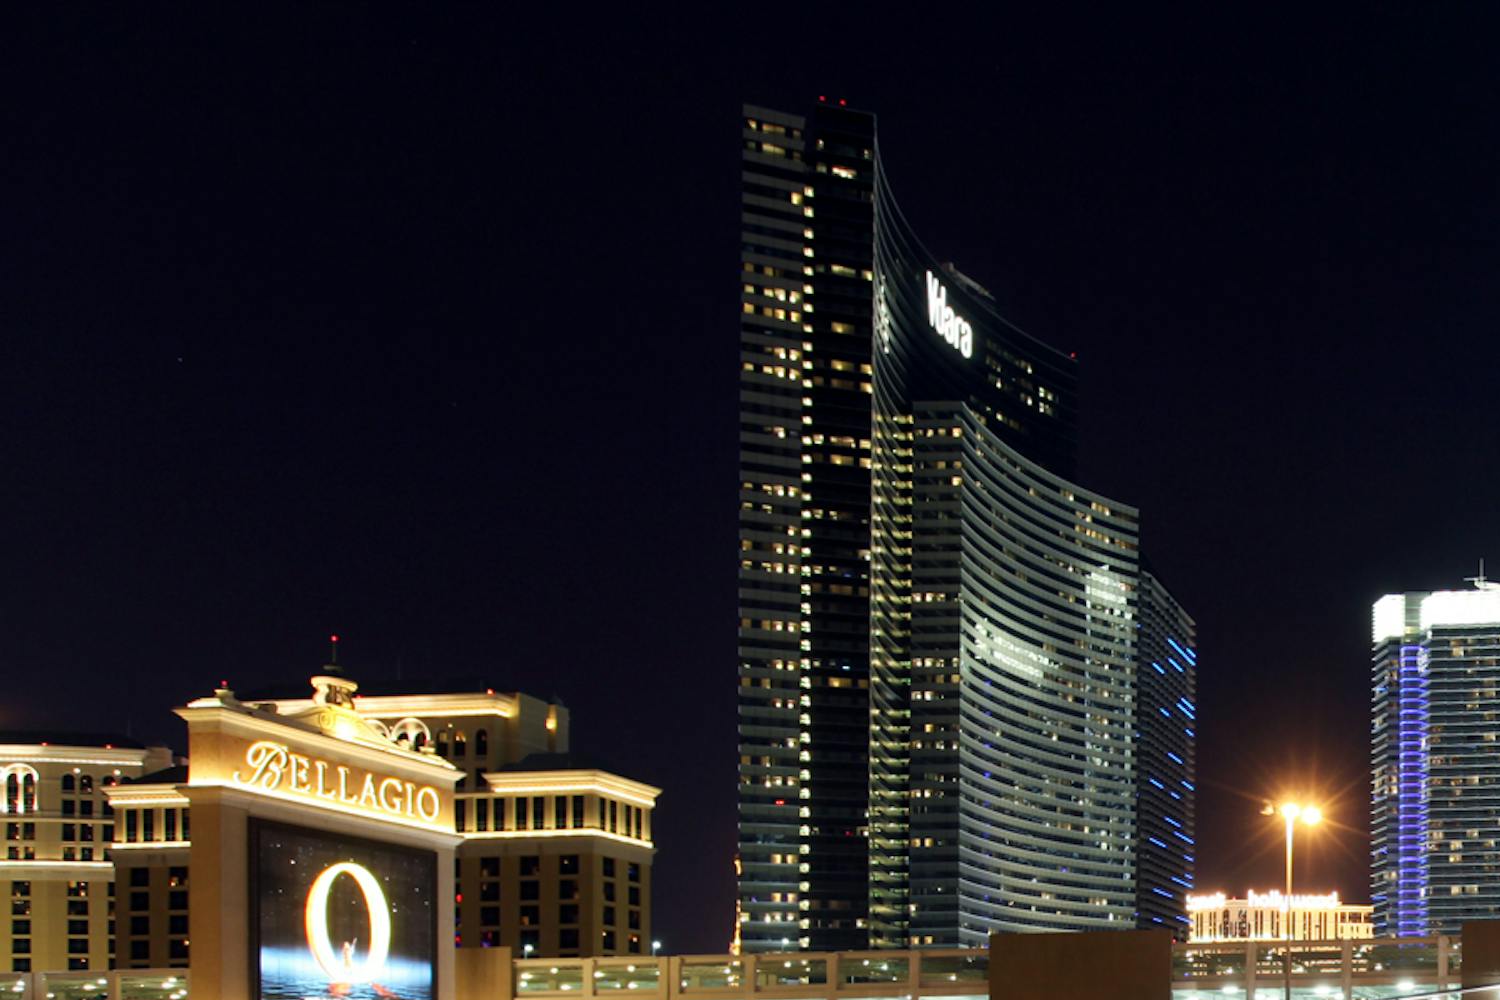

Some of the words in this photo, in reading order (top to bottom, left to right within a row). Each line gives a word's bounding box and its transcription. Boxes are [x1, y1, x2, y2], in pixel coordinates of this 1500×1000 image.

[926, 270, 973, 359] Vdara
[233, 741, 440, 823] BELLAGIO
[1248, 889, 1338, 912] hollywood
